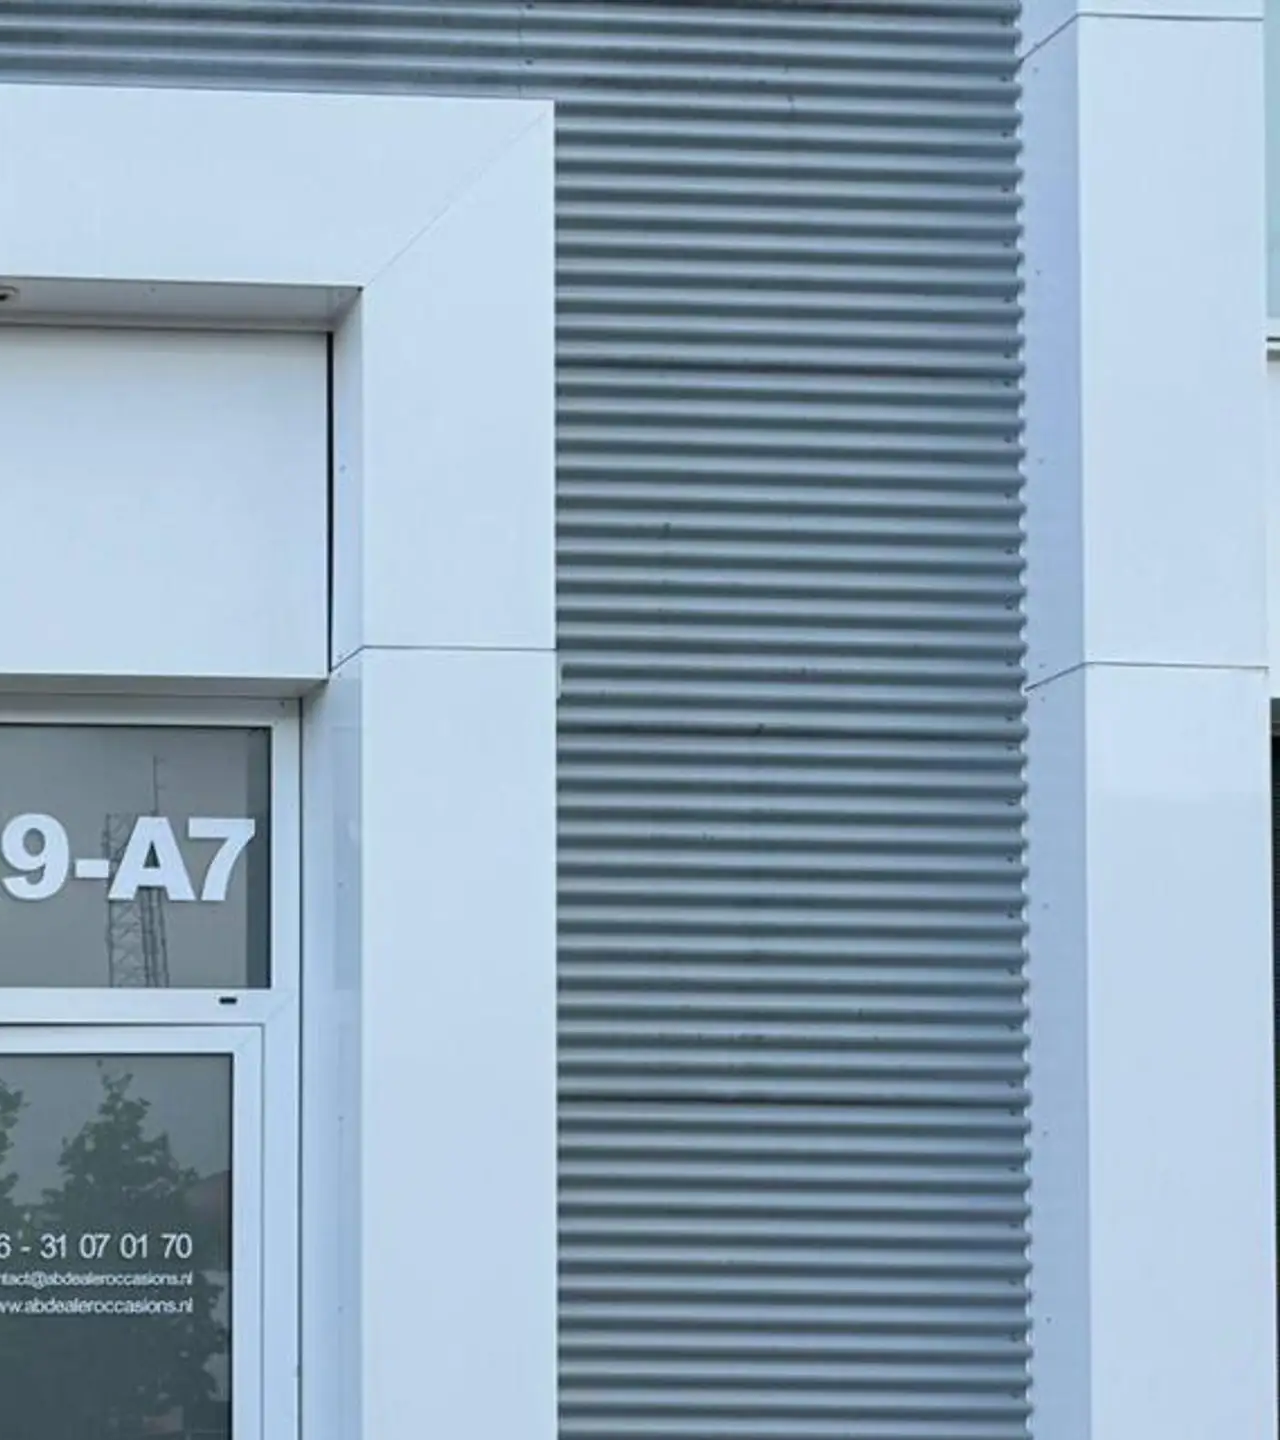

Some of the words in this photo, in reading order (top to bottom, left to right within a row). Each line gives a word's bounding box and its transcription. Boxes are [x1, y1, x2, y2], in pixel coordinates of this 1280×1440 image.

[40, 1232, 67, 1259] 31
[79, 1232, 111, 1259] 07
[120, 1232, 148, 1259] 01
[161, 1233, 193, 1259] 70
